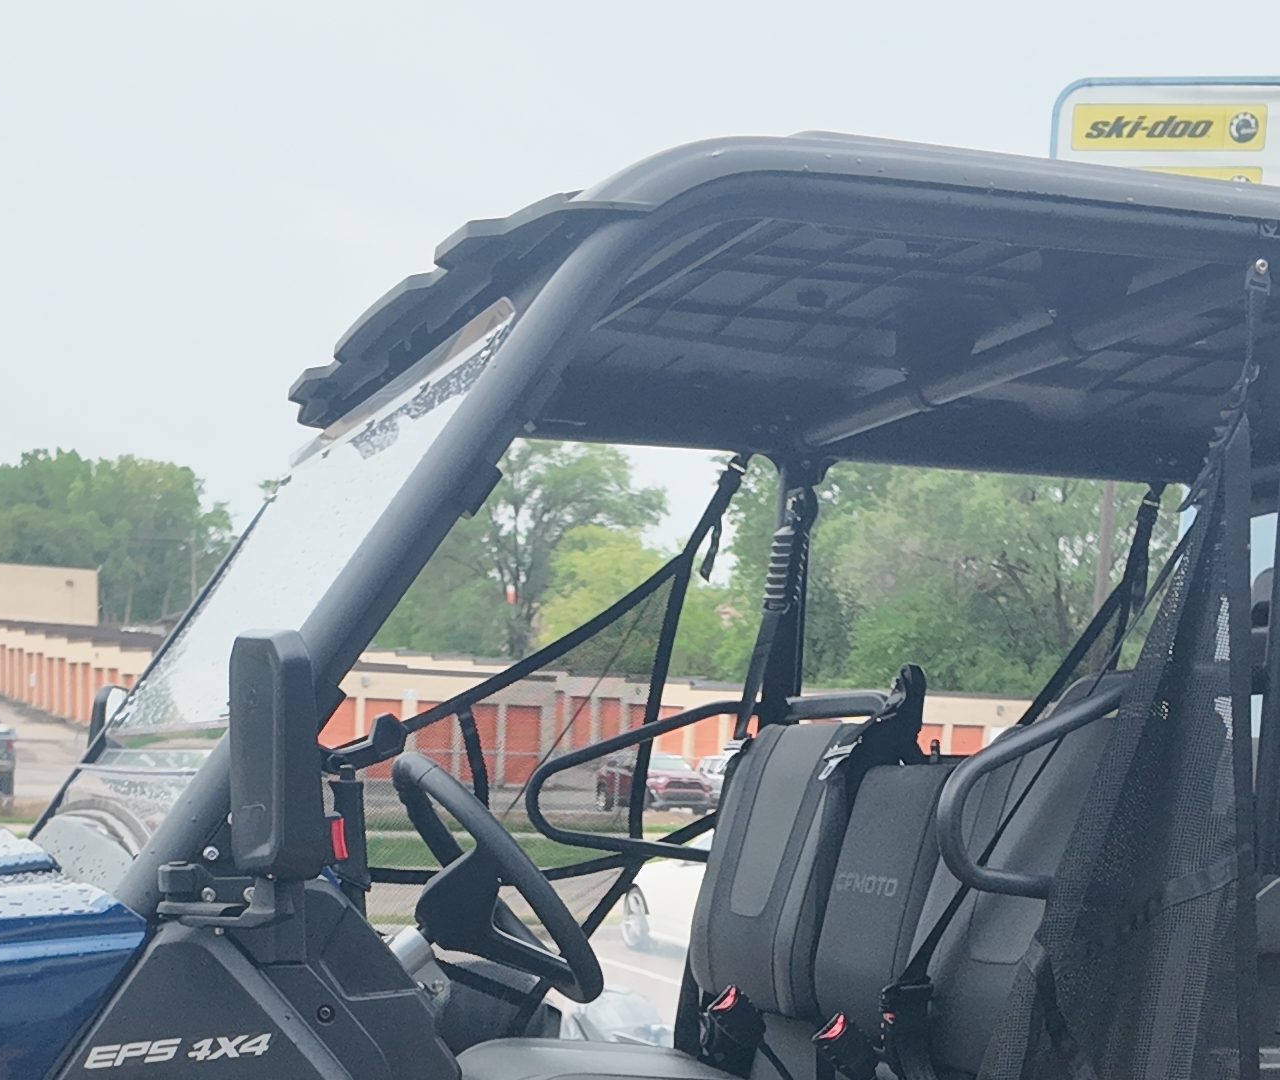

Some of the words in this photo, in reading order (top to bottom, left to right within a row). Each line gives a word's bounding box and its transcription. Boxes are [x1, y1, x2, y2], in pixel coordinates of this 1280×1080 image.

[1085, 115, 1214, 139] ski-doo
[835, 871, 898, 898] CFMOTO
[84, 1037, 183, 1070] EPS
[187, 1033, 272, 1062] 4X4
